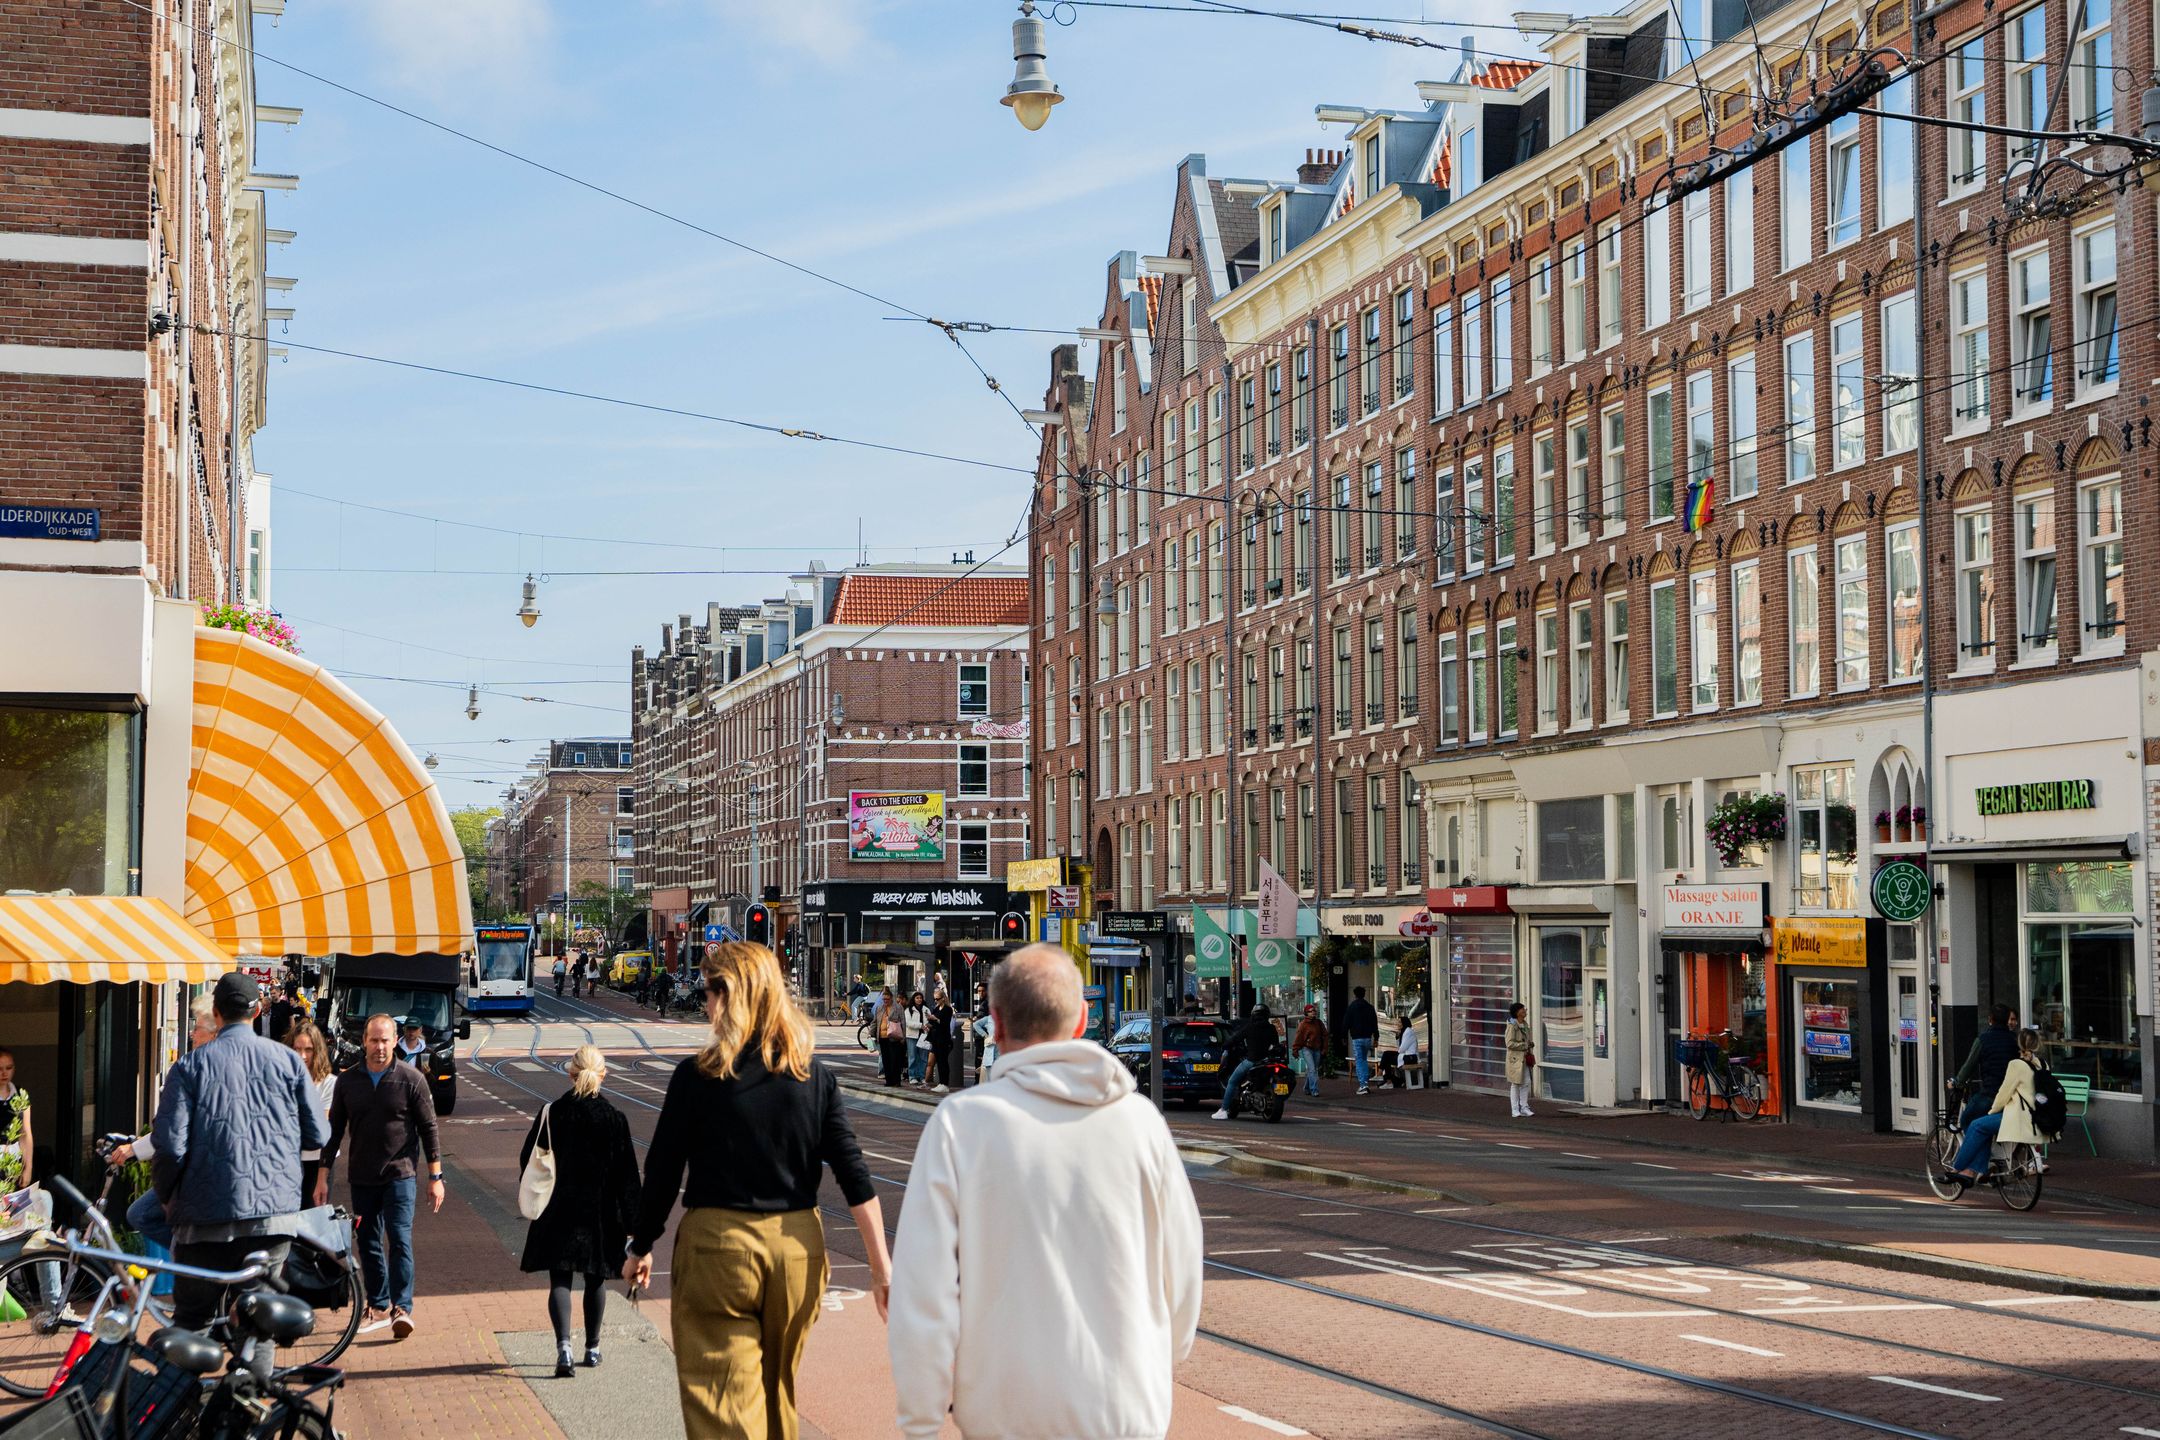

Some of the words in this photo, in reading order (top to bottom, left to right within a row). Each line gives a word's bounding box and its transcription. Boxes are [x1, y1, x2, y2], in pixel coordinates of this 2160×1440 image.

[1, 509, 94, 527] LDERDIJKKADE
[48, 526, 92, 537] OUD-WEST
[861, 797, 878, 807] BACK
[880, 797, 888, 805] TO
[889, 796, 901, 805] THE
[901, 795, 923, 805] OFFICE
[1976, 785, 2017, 815] VEGAN
[2020, 782, 2059, 812] SUSHI
[2061, 779, 2091, 809] BAR
[862, 807, 884, 818] Spreek
[873, 830, 918, 848] Aloha
[1885, 866, 1923, 880] VEGAN
[872, 892, 905, 904] BAKERY
[905, 892, 929, 904] CAFE
[931, 888, 984, 906] MENSINK
[1667, 889, 1718, 906] Massage
[1722, 887, 1758, 902] Salon
[1881, 889, 1908, 917] SUSHI
[1914, 889, 1928, 912] BAR
[1260, 877, 1272, 935] 서울푸드
[1364, 914, 1384, 926] FOOD
[1681, 910, 1744, 924] ORANJE
[709, 945, 719, 954] 30
[1443, 1266, 1812, 1297] BUS
